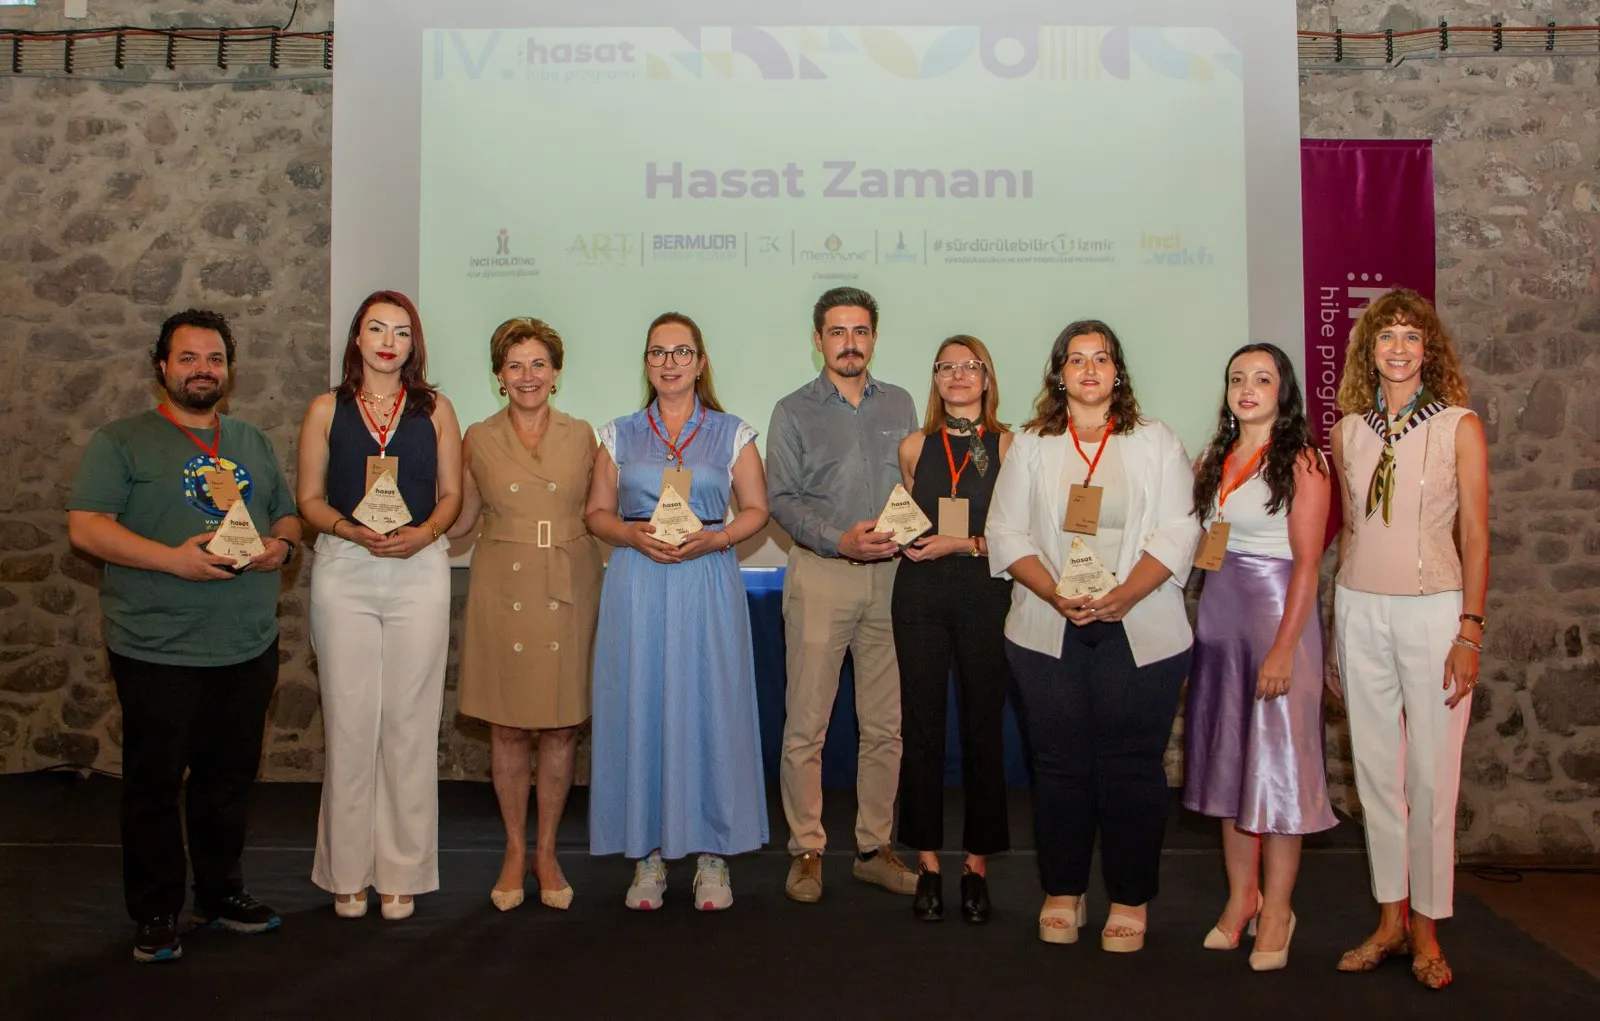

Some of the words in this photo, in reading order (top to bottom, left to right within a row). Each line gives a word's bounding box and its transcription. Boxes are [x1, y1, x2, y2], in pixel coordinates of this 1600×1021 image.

[526, 37, 636, 64] hasat
[527, 68, 560, 80] hibe
[645, 161, 806, 199] Hasat
[821, 160, 1034, 199] Zamanı
[570, 232, 634, 260] ART
[652, 234, 737, 250] BERMUDA
[1320, 287, 1340, 337] hibe
[375, 487, 395, 495] hasat
[230, 519, 249, 527] hasat
[1071, 556, 1093, 565] hasat
